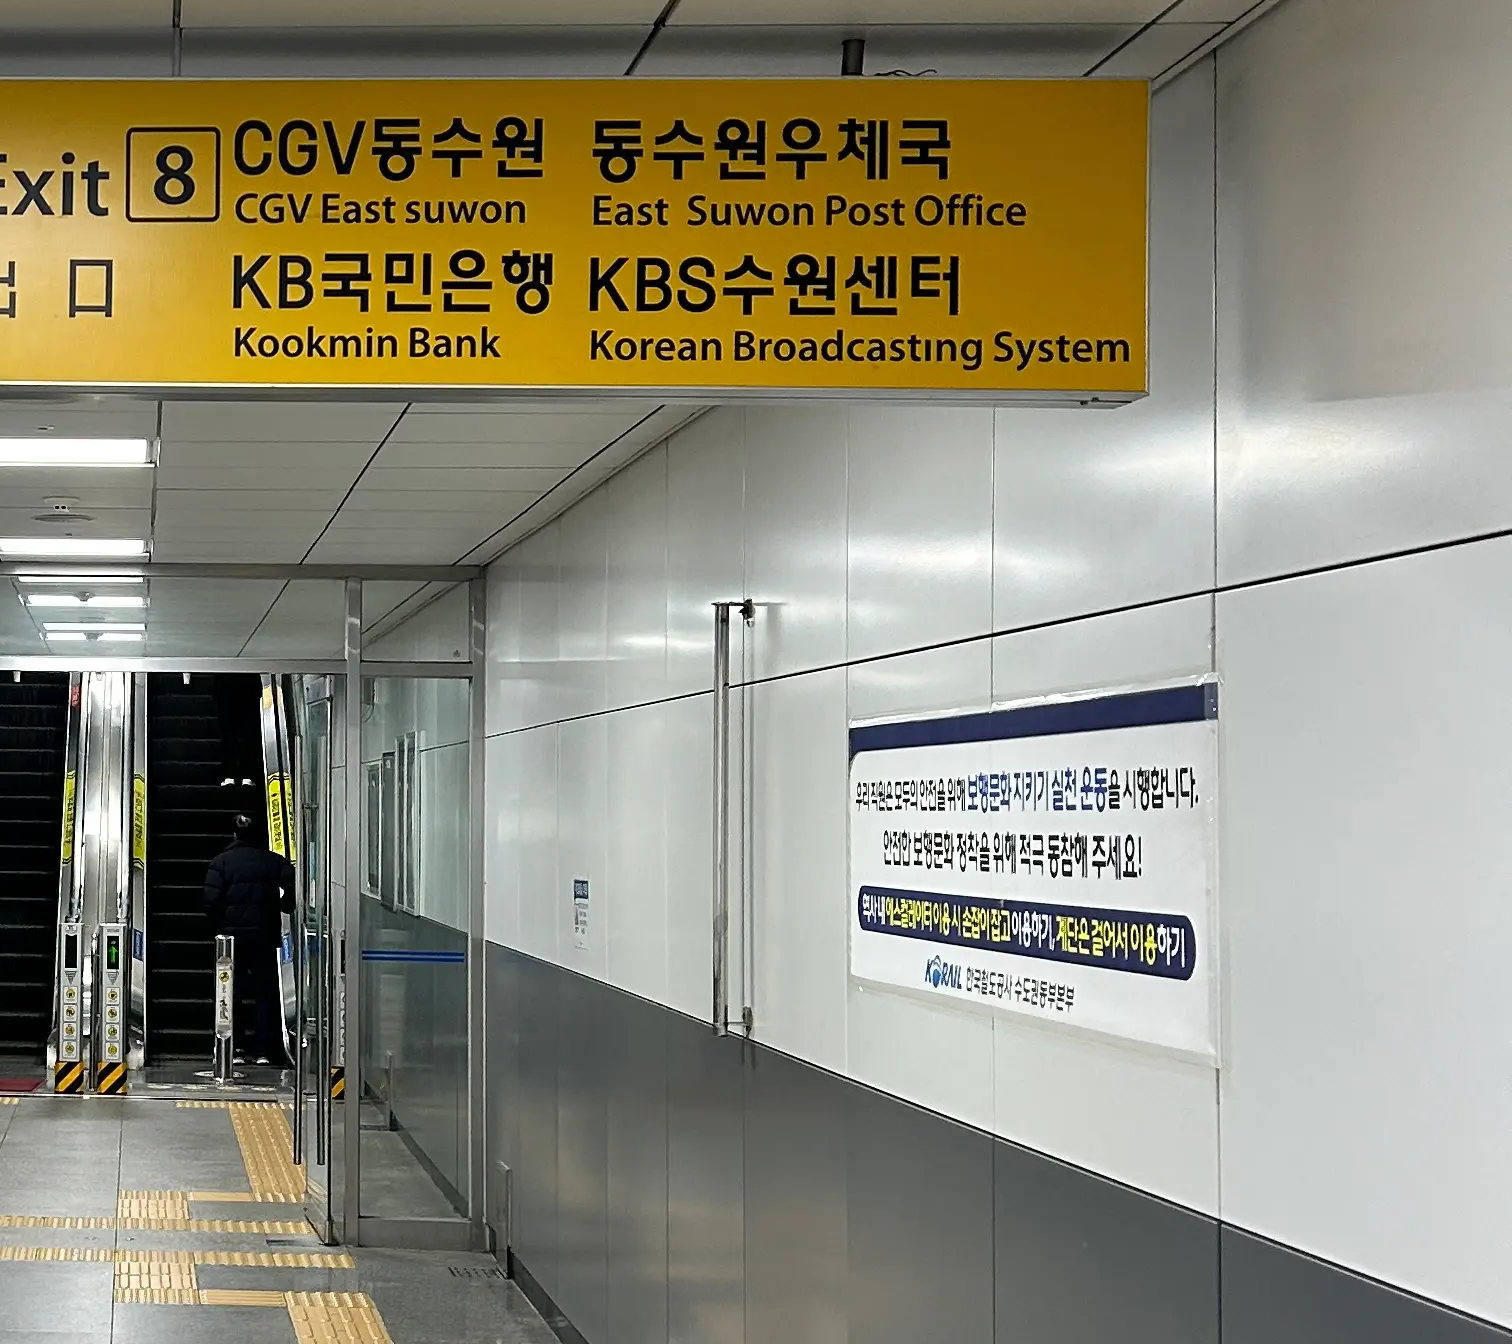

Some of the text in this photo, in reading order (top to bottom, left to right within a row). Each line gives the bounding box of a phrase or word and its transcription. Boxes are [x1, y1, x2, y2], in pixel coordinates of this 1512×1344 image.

[234, 116, 544, 182] CGV동수원
[592, 117, 952, 183] 동수원우체국
[154, 145, 196, 205] 8
[235, 192, 526, 224] CGV East suwon
[593, 193, 1027, 226] East Suwon Post Office
[233, 249, 554, 315] KB국민은행
[589, 253, 960, 316] KBS수원센터
[234, 325, 501, 358] Kookmin Bank
[590, 330, 1130, 371] Korean Broadcasting System
[856, 766, 1199, 813] 우리 직원은 모두의 안전을 위해 보행문화 지키기 실천 운동을 시행합니다.
[883, 829, 1142, 880] 안전한 보행문화 정착을 위해 적극 동참해 주세요!
[862, 894, 878, 923] 역사
[886, 896, 933, 932] 에스컬레이터
[933, 902, 951, 936] 이용
[952, 904, 962, 936] 시
[962, 906, 990, 940] 손잡이
[990, 908, 1012, 942] 잡고
[1012, 910, 1056, 951] 이용하기,
[1056, 915, 1090, 955] 계단은
[1091, 918, 1128, 960] 걸어서
[1130, 922, 1186, 968] 이용하기
[924, 954, 962, 990] KORAIL
[966, 966, 1013, 1001] 한국철도공사
